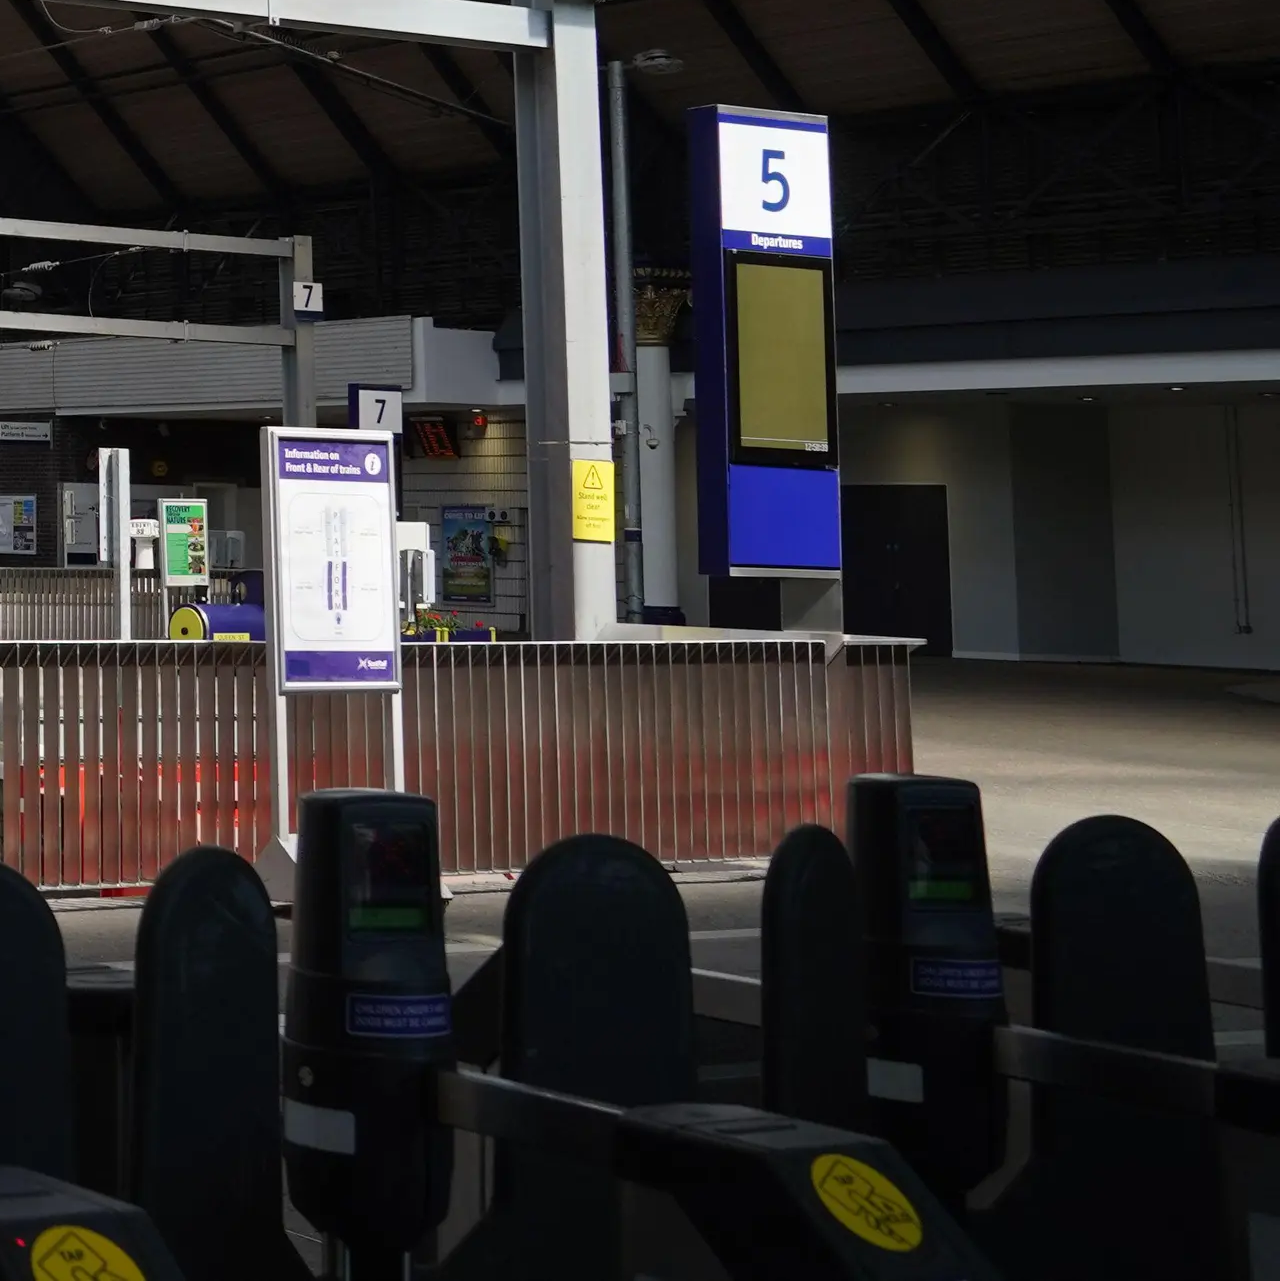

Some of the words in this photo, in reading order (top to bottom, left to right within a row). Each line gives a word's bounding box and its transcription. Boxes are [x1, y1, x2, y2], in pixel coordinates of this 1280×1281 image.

[761, 149, 790, 213] 5
[751, 233, 803, 250] Departures
[301, 284, 314, 309] 7
[374, 399, 387, 424] 7
[284, 449, 329, 461] Information
[329, 453, 340, 461] on
[285, 462, 306, 473] Front
[306, 463, 313, 473] &
[313, 464, 329, 474] Rear
[330, 464, 339, 474] of
[339, 465, 361, 475] trains
[578, 491, 595, 500] Stand
[596, 493, 608, 501] well
[166, 505, 190, 513] RECOVERY
[57, 1248, 84, 1262] TAP
